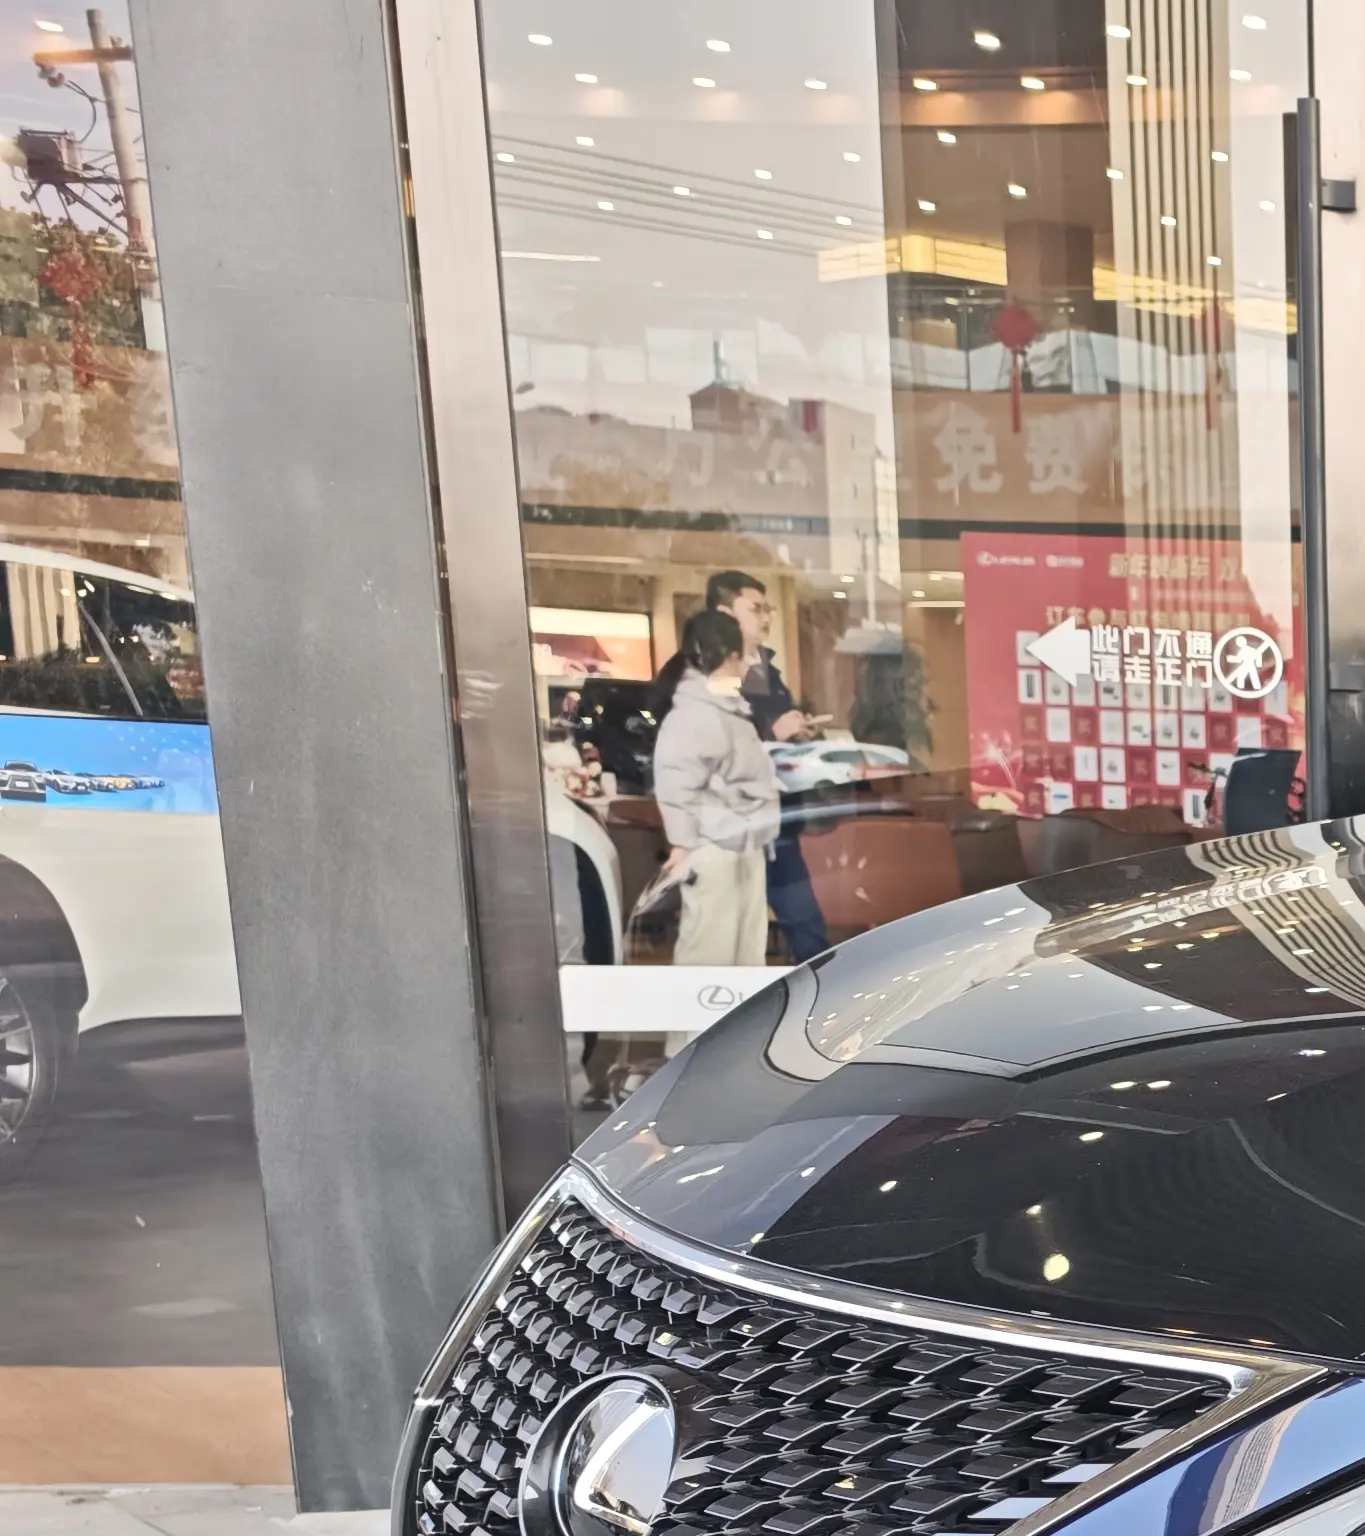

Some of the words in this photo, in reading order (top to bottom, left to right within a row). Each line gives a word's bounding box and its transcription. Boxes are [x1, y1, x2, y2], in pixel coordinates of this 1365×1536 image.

[1092, 624, 1213, 660] 此门不通
[1091, 654, 1213, 688] 请走正门
